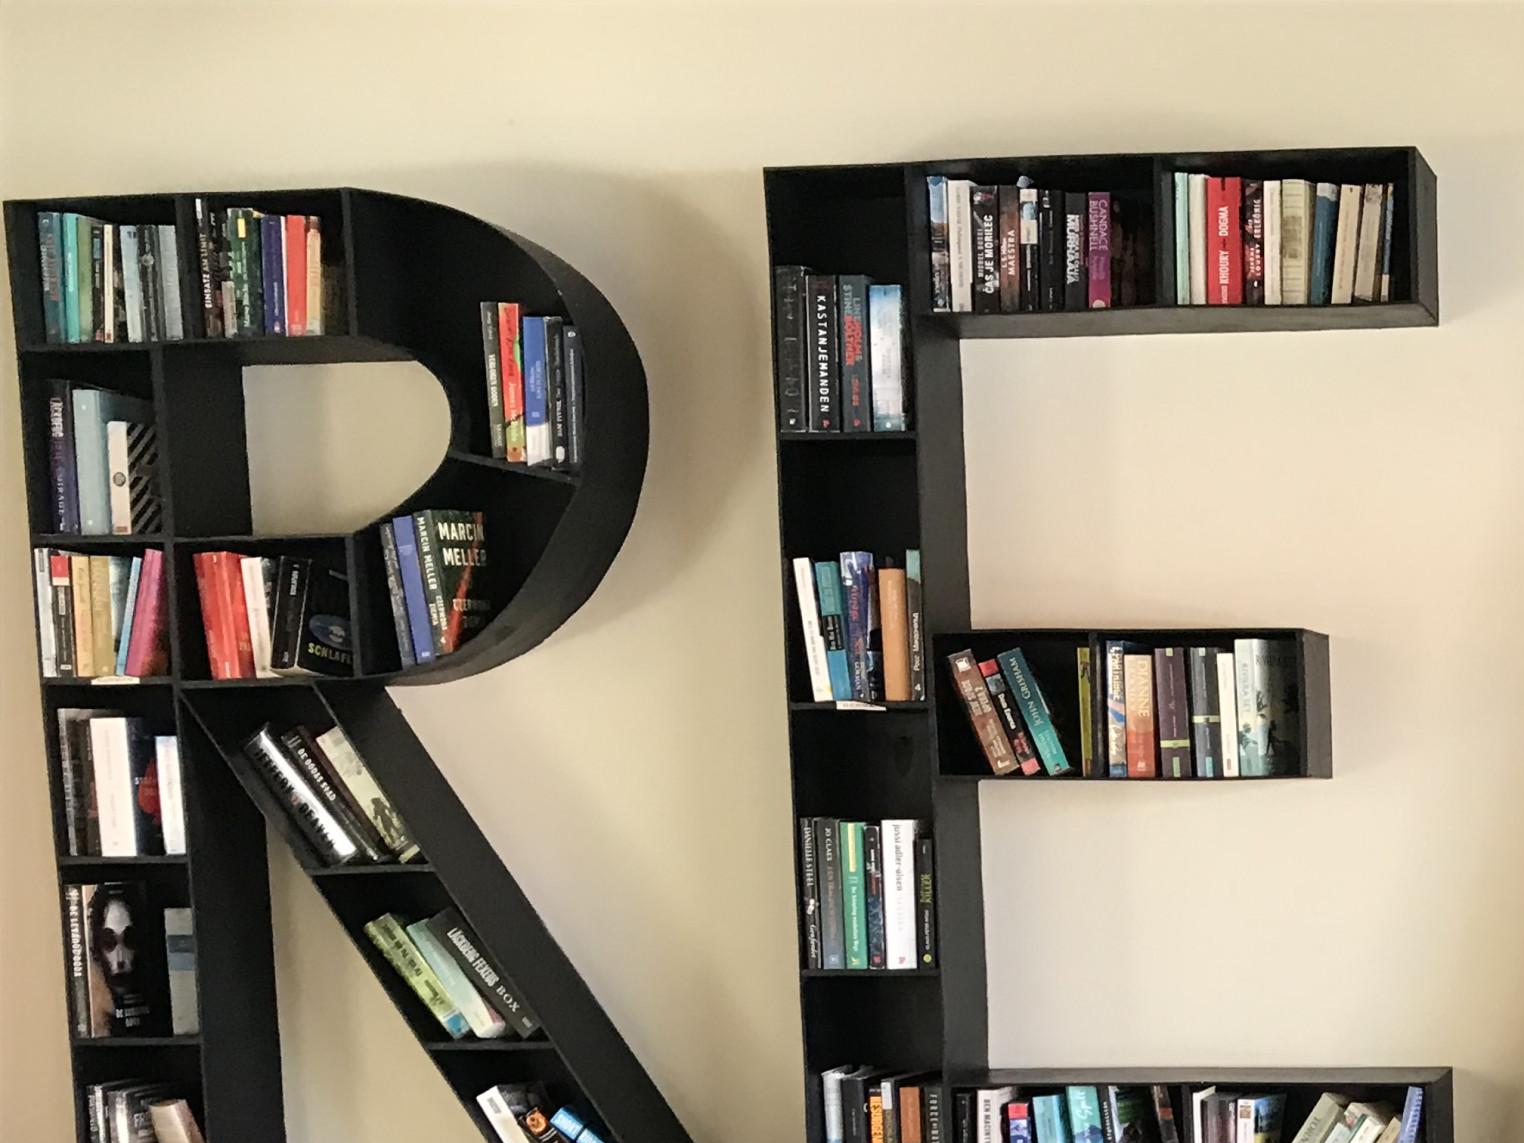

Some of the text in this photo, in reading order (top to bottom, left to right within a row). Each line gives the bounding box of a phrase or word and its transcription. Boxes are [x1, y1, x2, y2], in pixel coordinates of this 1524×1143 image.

[1088, 199, 1098, 251] BUSHNELL
[1095, 199, 1110, 251] CANDACE
[1218, 205, 1229, 236] DOGMA
[980, 214, 995, 294] ČAS JE MORILEC
[1007, 228, 1015, 275] MAESTRA
[1066, 213, 1075, 284] MURHAAJA
[1218, 249, 1229, 284] KHOURY
[200, 272, 213, 308] EINSATZ
[841, 283, 855, 315] STINE
[815, 294, 830, 412] KASTANJEMANDEN
[437, 521, 484, 544] MARCIN
[415, 515, 438, 590] MARCIN MELLER
[441, 546, 487, 567] MELLER
[1006, 655, 1044, 727] JOHN GRISHAM
[1138, 660, 1150, 718] DIANNE
[823, 826, 834, 862] JO CLAES
[891, 823, 902, 843] jussi
[804, 862, 814, 887] STEEL
[471, 955, 501, 988] FEXEUS
[494, 983, 521, 1014] BOX
[926, 1092, 939, 1122] FORCE
[982, 1098, 991, 1112] BEN
